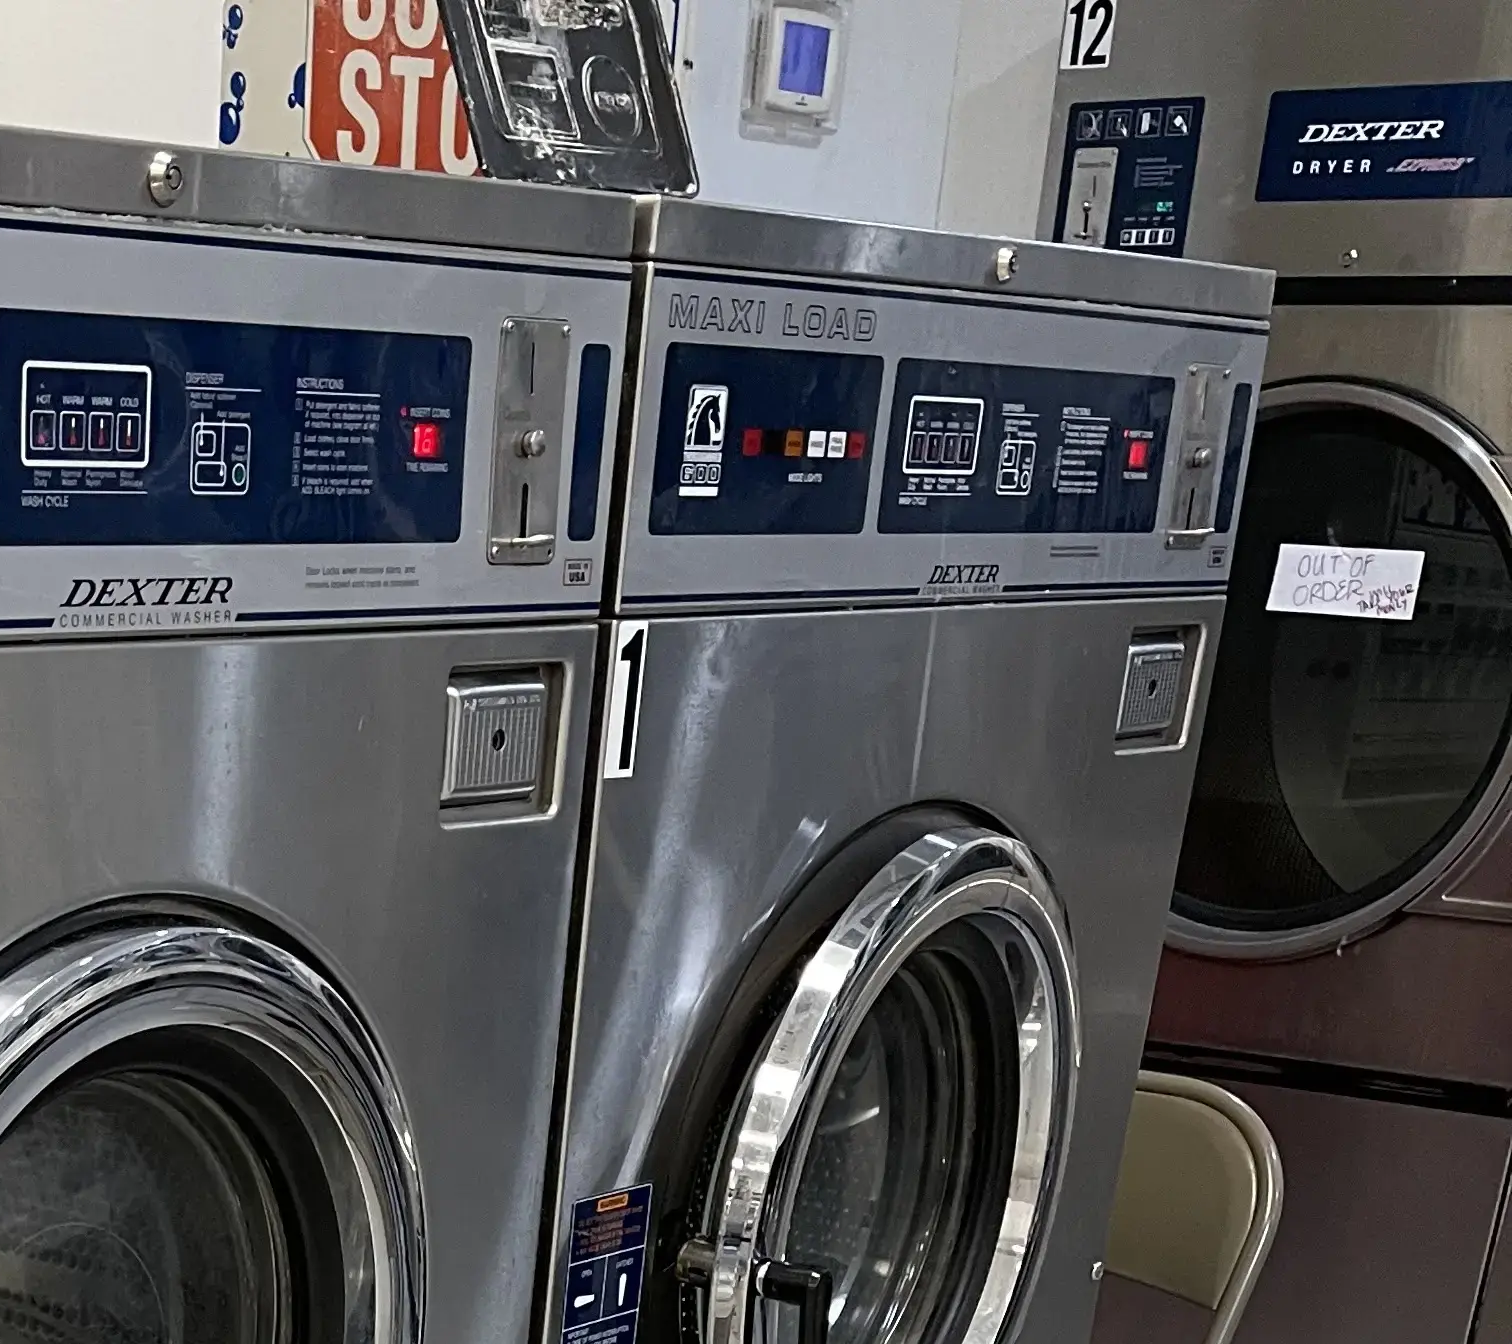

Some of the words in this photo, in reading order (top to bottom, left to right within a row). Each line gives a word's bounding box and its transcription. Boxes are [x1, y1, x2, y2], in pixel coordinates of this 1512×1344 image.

[1069, 0, 1113, 66] 12
[1298, 120, 1444, 143] DEXTER
[1292, 159, 1372, 174] DRYER
[668, 293, 766, 334] MAXI
[782, 303, 877, 342] LOAD
[296, 377, 345, 390] INSTRUCTIONS
[35, 394, 51, 405] HOT
[680, 463, 722, 484] 600
[44, 496, 69, 508] CYCLE
[926, 564, 1000, 584] DEXTER
[1298, 554, 1342, 578] OUT
[1349, 554, 1376, 578] OF
[568, 572, 586, 582] USA
[59, 577, 234, 607] DEXTER
[1292, 579, 1365, 607] ORDER
[59, 612, 162, 628] COMMERCIAL
[171, 609, 232, 625] WASHER
[619, 629, 645, 770] 1
